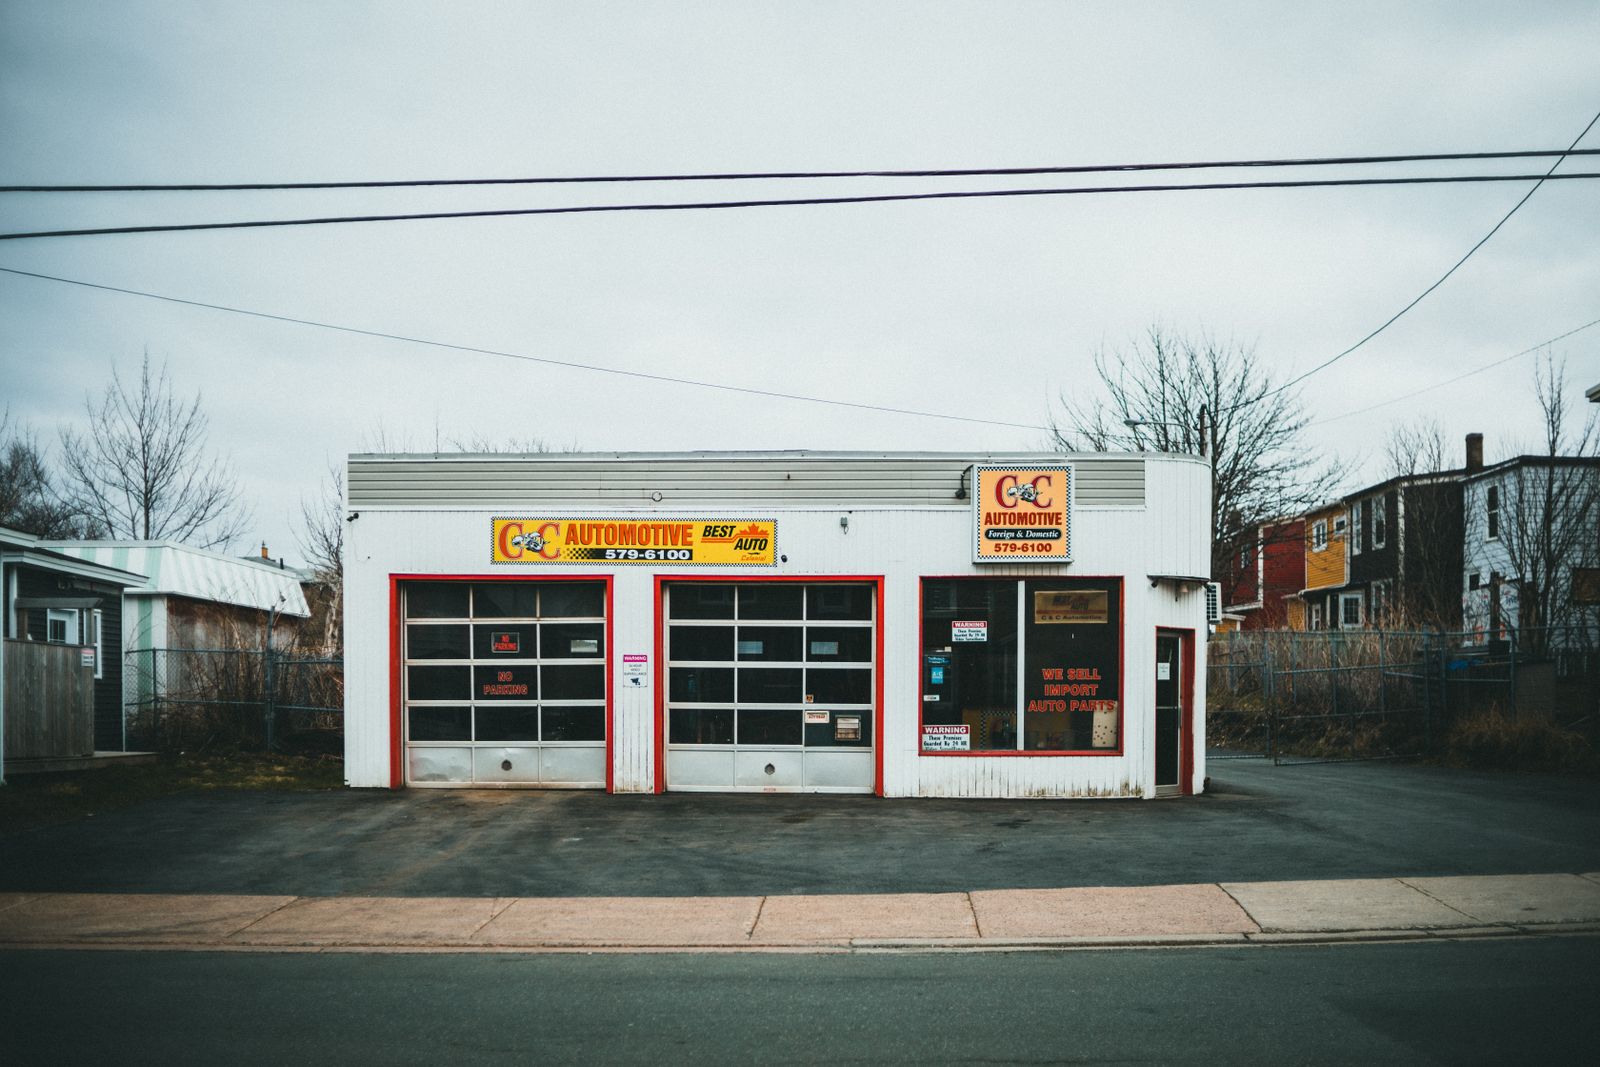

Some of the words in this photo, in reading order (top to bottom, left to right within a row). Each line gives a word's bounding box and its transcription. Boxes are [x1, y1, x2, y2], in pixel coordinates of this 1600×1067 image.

[984, 512, 1062, 526] AUTOMOTIVE
[565, 523, 693, 546] AUTOMOTIVE
[702, 525, 736, 538] BEST
[988, 530, 1015, 539] Foreign
[1025, 530, 1059, 538] Domestic
[734, 538, 768, 551] AUTO
[994, 543, 1052, 552] 579-6100
[605, 549, 690, 560] 579-6100
[498, 671, 513, 682] NO
[1042, 668, 1064, 680] WE
[1067, 668, 1101, 680] SELL
[483, 684, 528, 695] PARKING
[1044, 684, 1098, 696] IMPORT
[1028, 700, 1066, 712] AUTO
[1070, 700, 1115, 712] PARTS
[925, 726, 967, 734] WARNING
